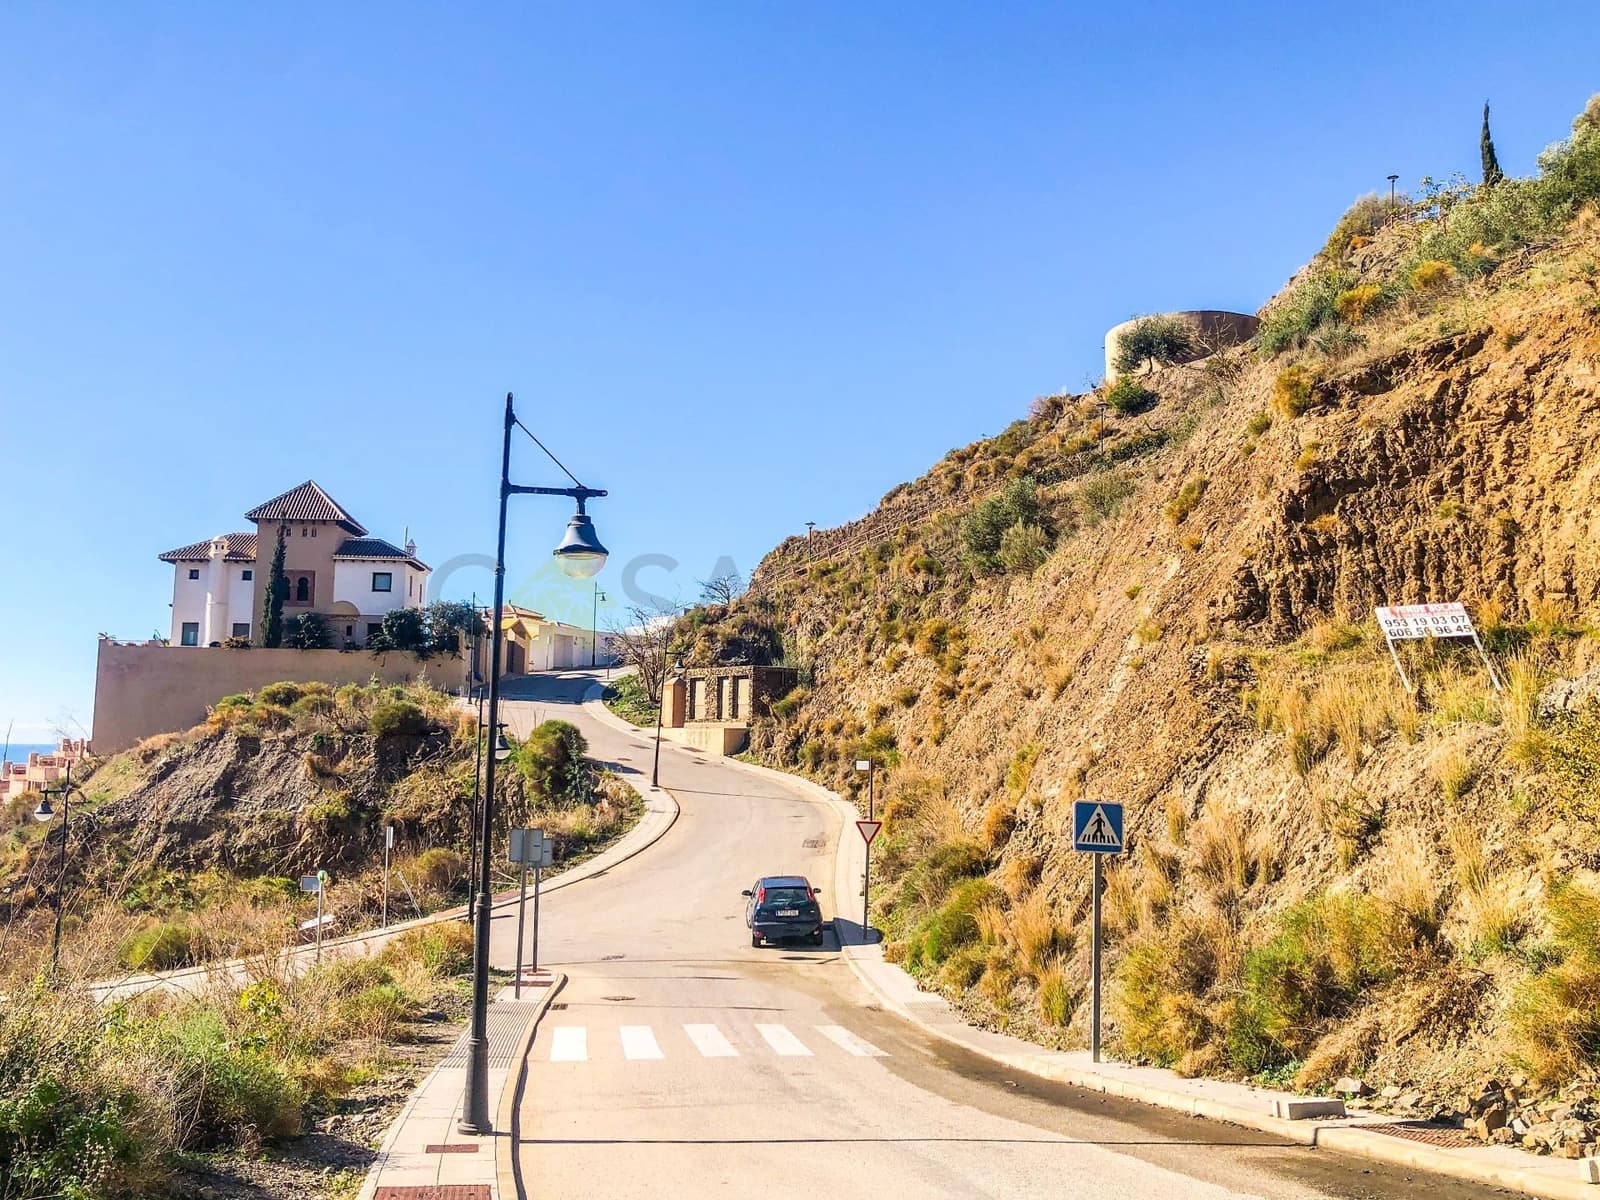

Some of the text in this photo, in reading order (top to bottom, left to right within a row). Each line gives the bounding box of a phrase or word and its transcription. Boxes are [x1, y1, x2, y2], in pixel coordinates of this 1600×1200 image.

[1413, 617, 1428, 626] 19
[1431, 616, 1448, 625] 03
[1451, 615, 1465, 624] 07
[1388, 627, 1412, 637] 606
[1456, 624, 1472, 633] 45
